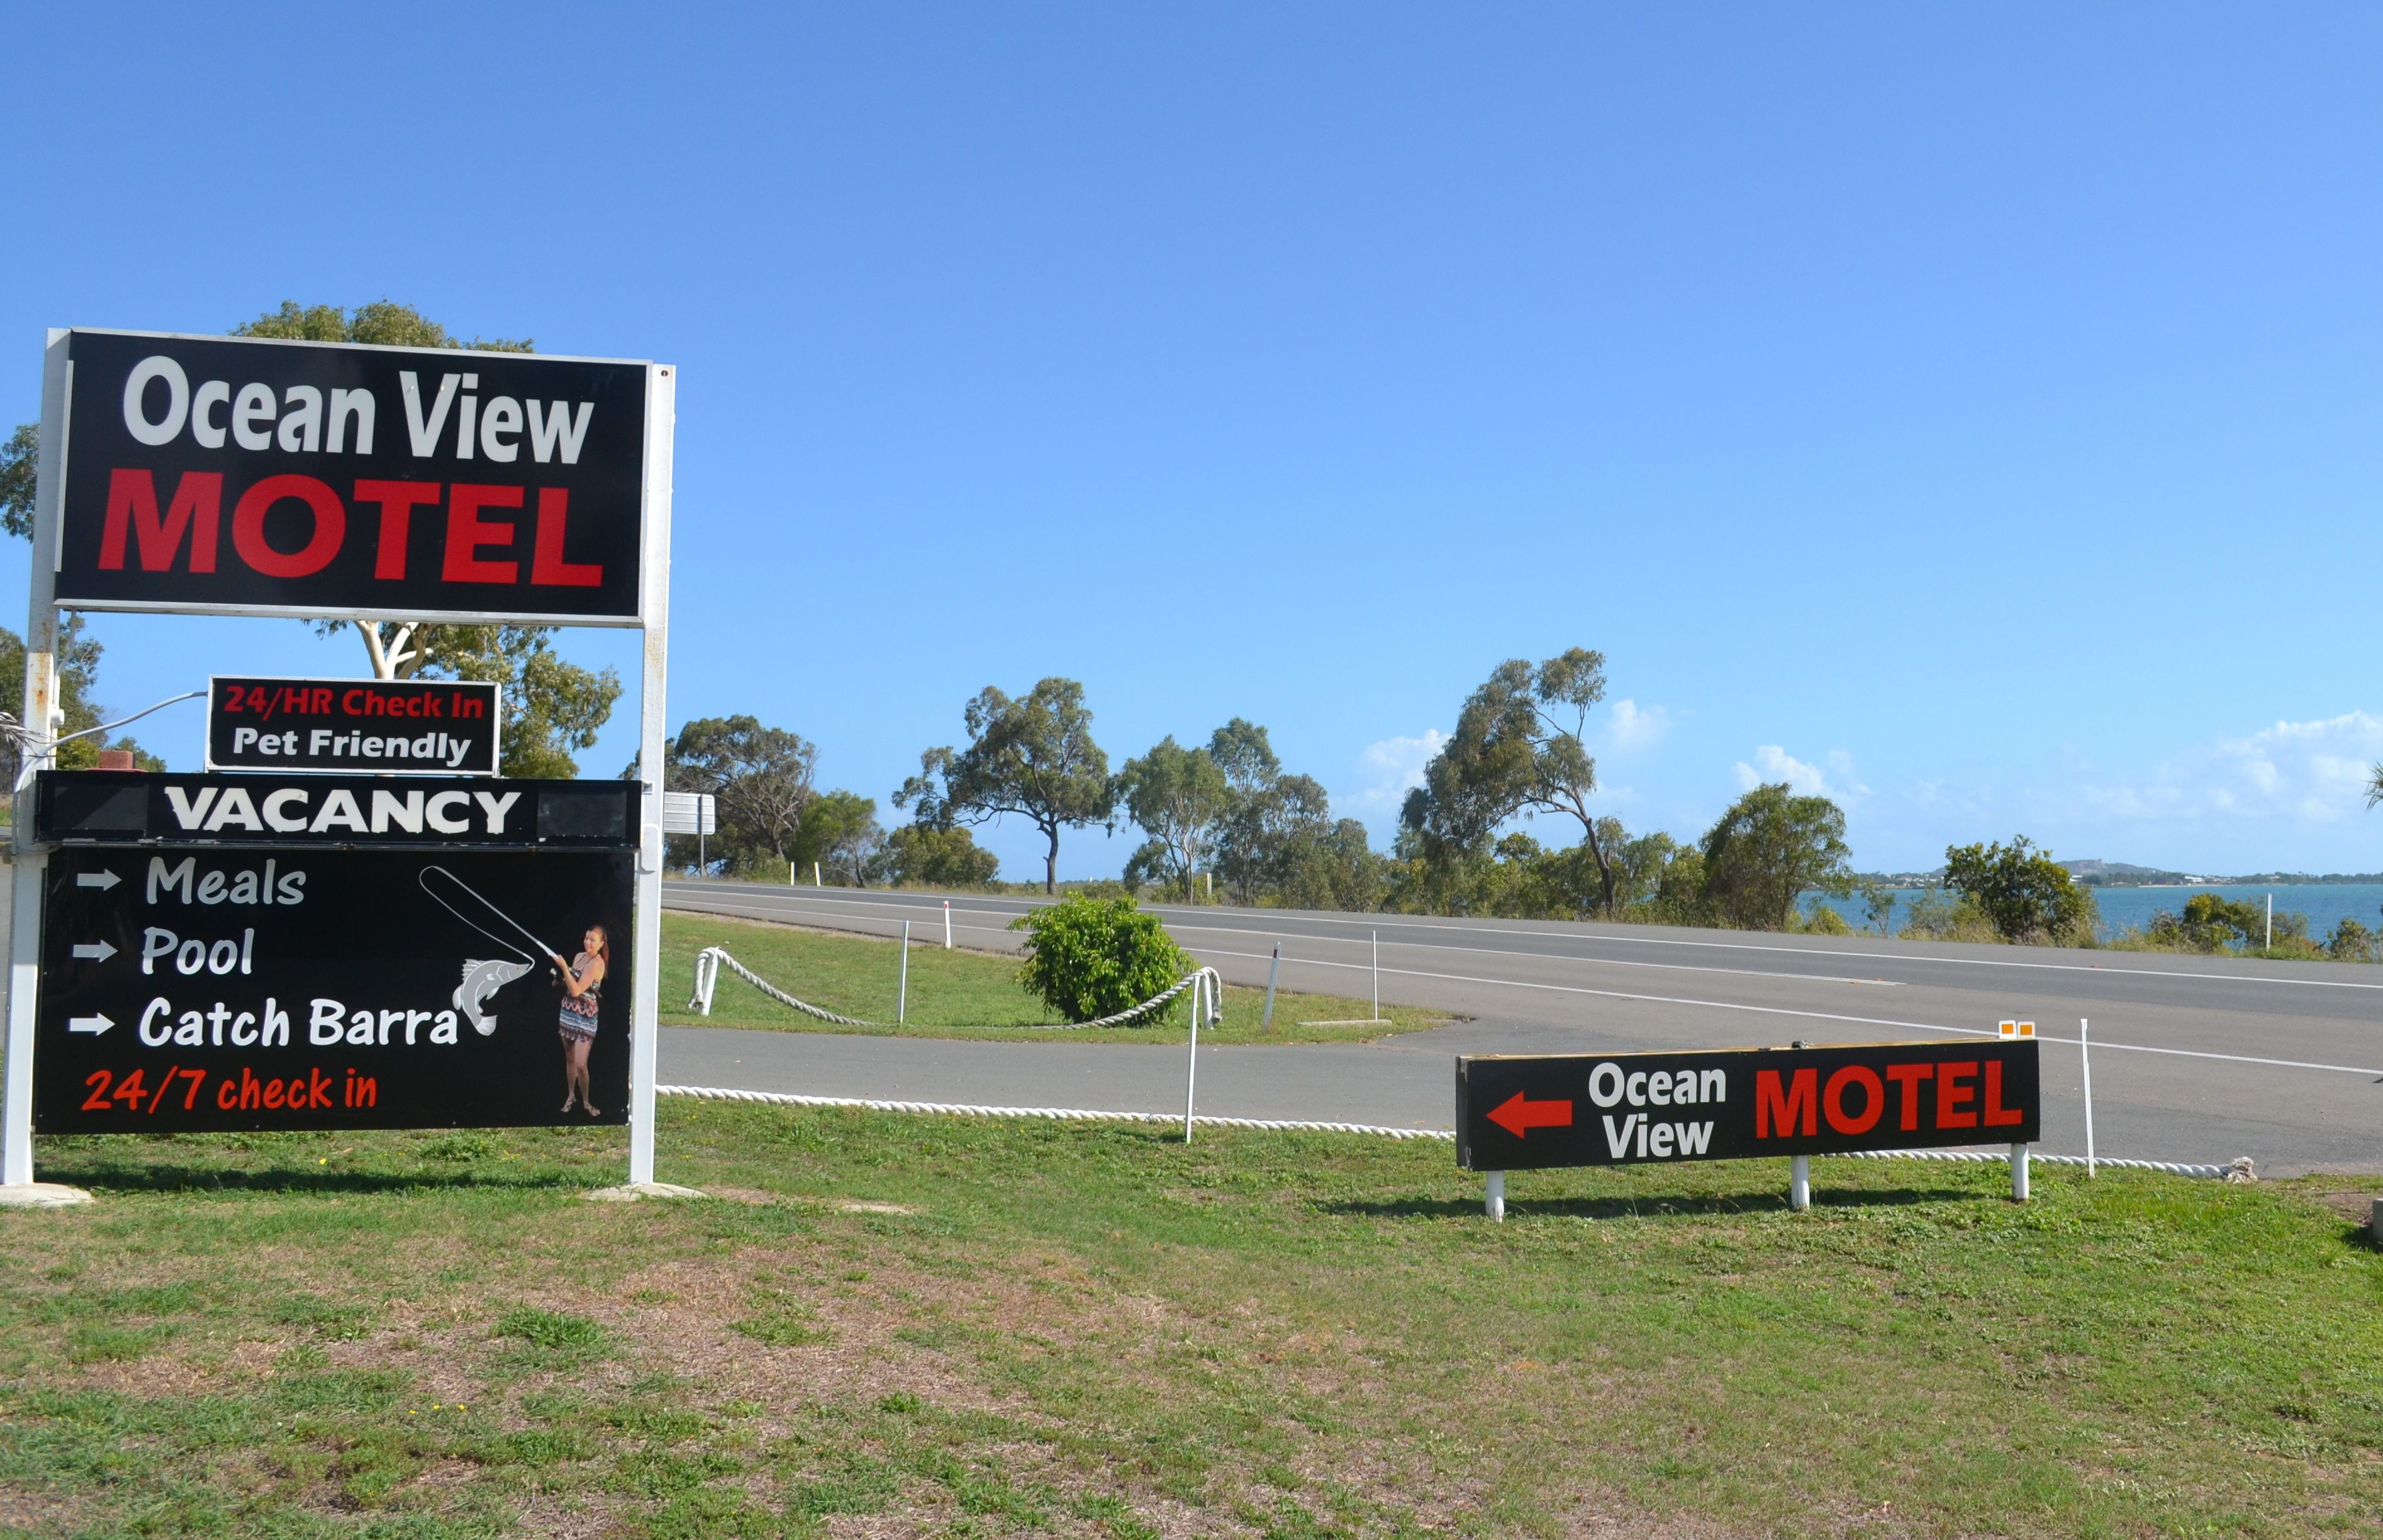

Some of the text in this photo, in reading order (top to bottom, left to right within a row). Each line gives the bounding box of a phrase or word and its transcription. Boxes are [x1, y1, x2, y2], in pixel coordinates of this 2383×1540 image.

[123, 355, 594, 464] Ocean View
[99, 468, 603, 586] MOTEL
[225, 686, 483, 720] 24/HR Check In
[233, 728, 472, 767] Pet Friendly
[165, 787, 521, 834] VACANCY
[147, 857, 306, 905] Meals
[142, 927, 254, 974] Pool
[139, 997, 458, 1046] Catch Barra
[82, 1066, 376, 1113] 24/7 check in
[1589, 1063, 1726, 1107] Ocean
[1756, 1061, 2023, 1138] MOTEL
[1602, 1113, 1714, 1158] View
